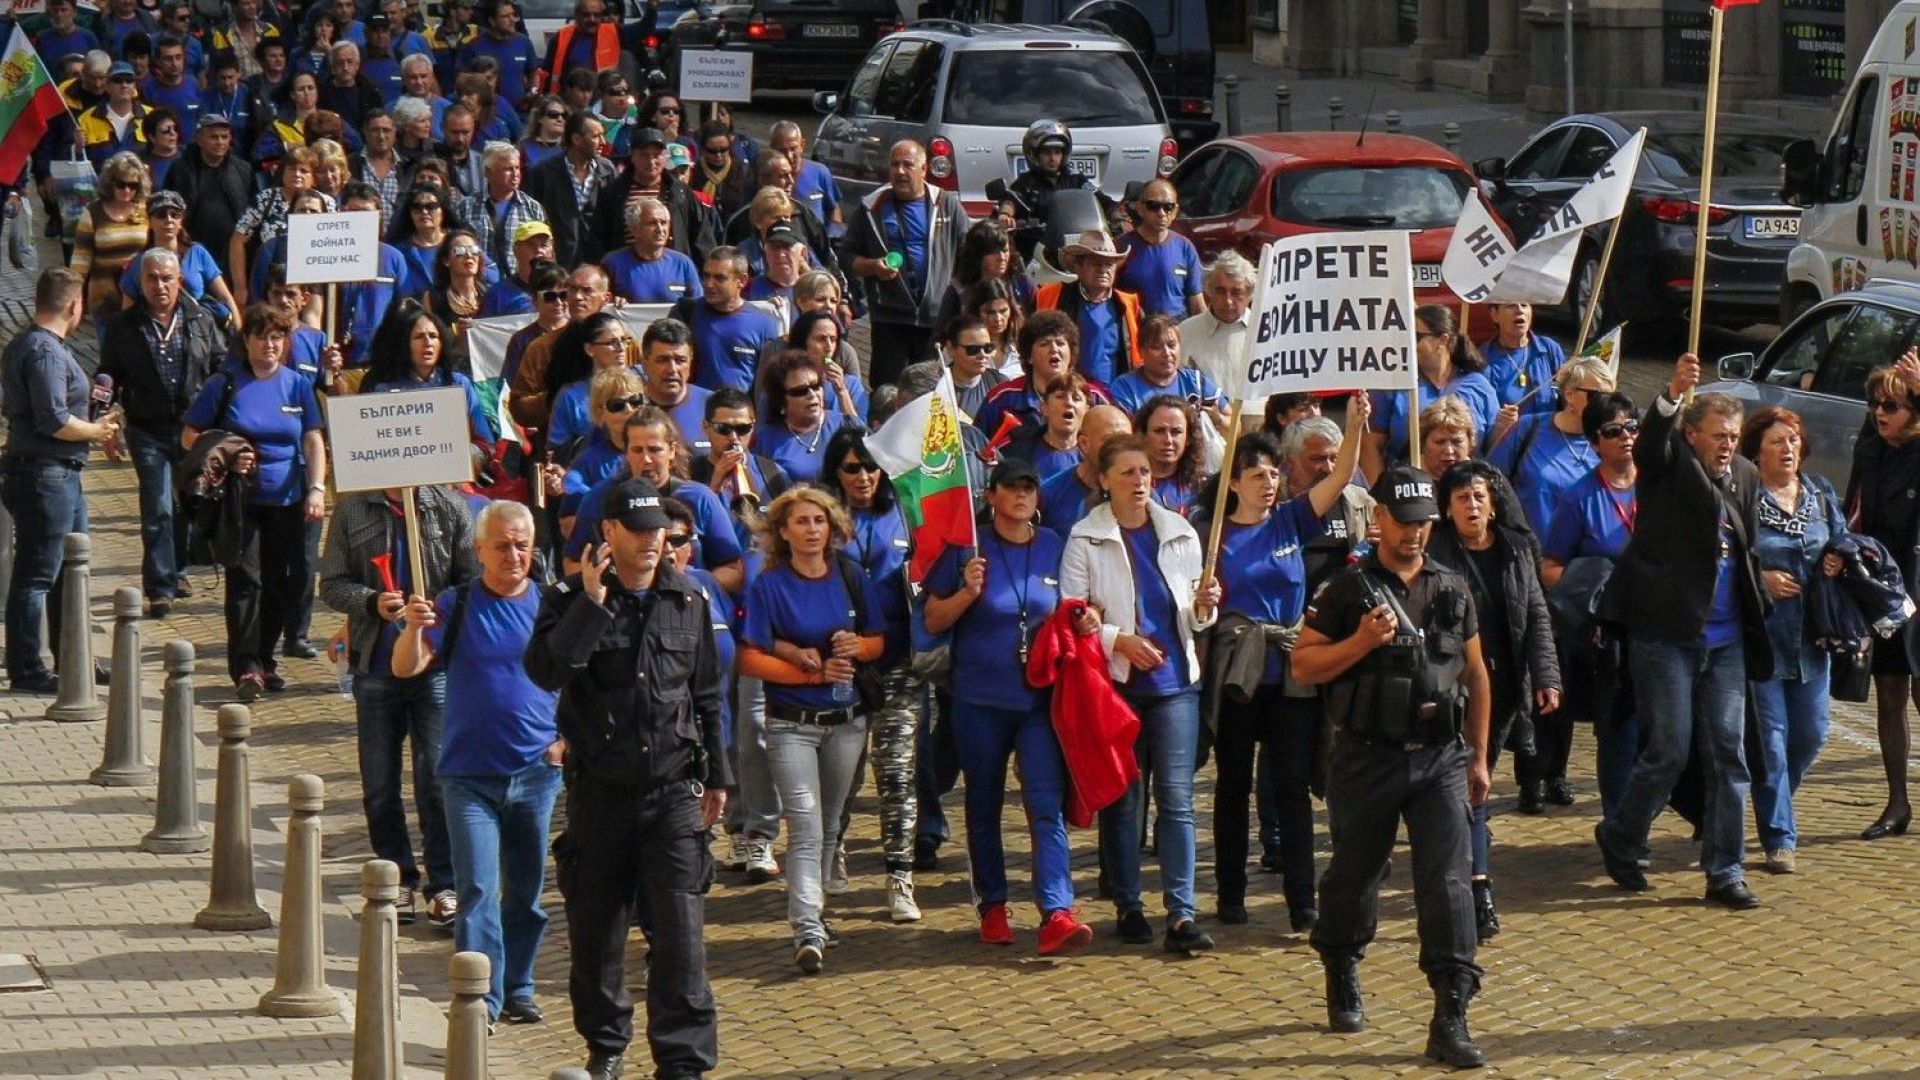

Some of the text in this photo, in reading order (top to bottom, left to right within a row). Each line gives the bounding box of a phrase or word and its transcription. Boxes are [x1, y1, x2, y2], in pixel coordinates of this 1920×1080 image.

[316, 221, 351, 231] СПРЕТЕ
[1754, 218, 1772, 233] CA
[310, 237, 356, 248] ВОЙНАТА
[1464, 224, 1506, 268] НЕ
[305, 254, 360, 265] СРЕЩУ НАС
[1270, 245, 1389, 288] СПРЕТЕ
[1257, 293, 1407, 344] ВОЙНАТА
[1248, 346, 1409, 383] СРЕЩУ НАС!
[360, 402, 434, 419] БЪЛГАРИЯ
[377, 426, 422, 439] НЕ ВИ Е
[350, 442, 453, 461] ЗАДНИЯ ДВОР !!!
[1394, 482, 1433, 499] POLICE
[629, 496, 661, 509] POLICE
